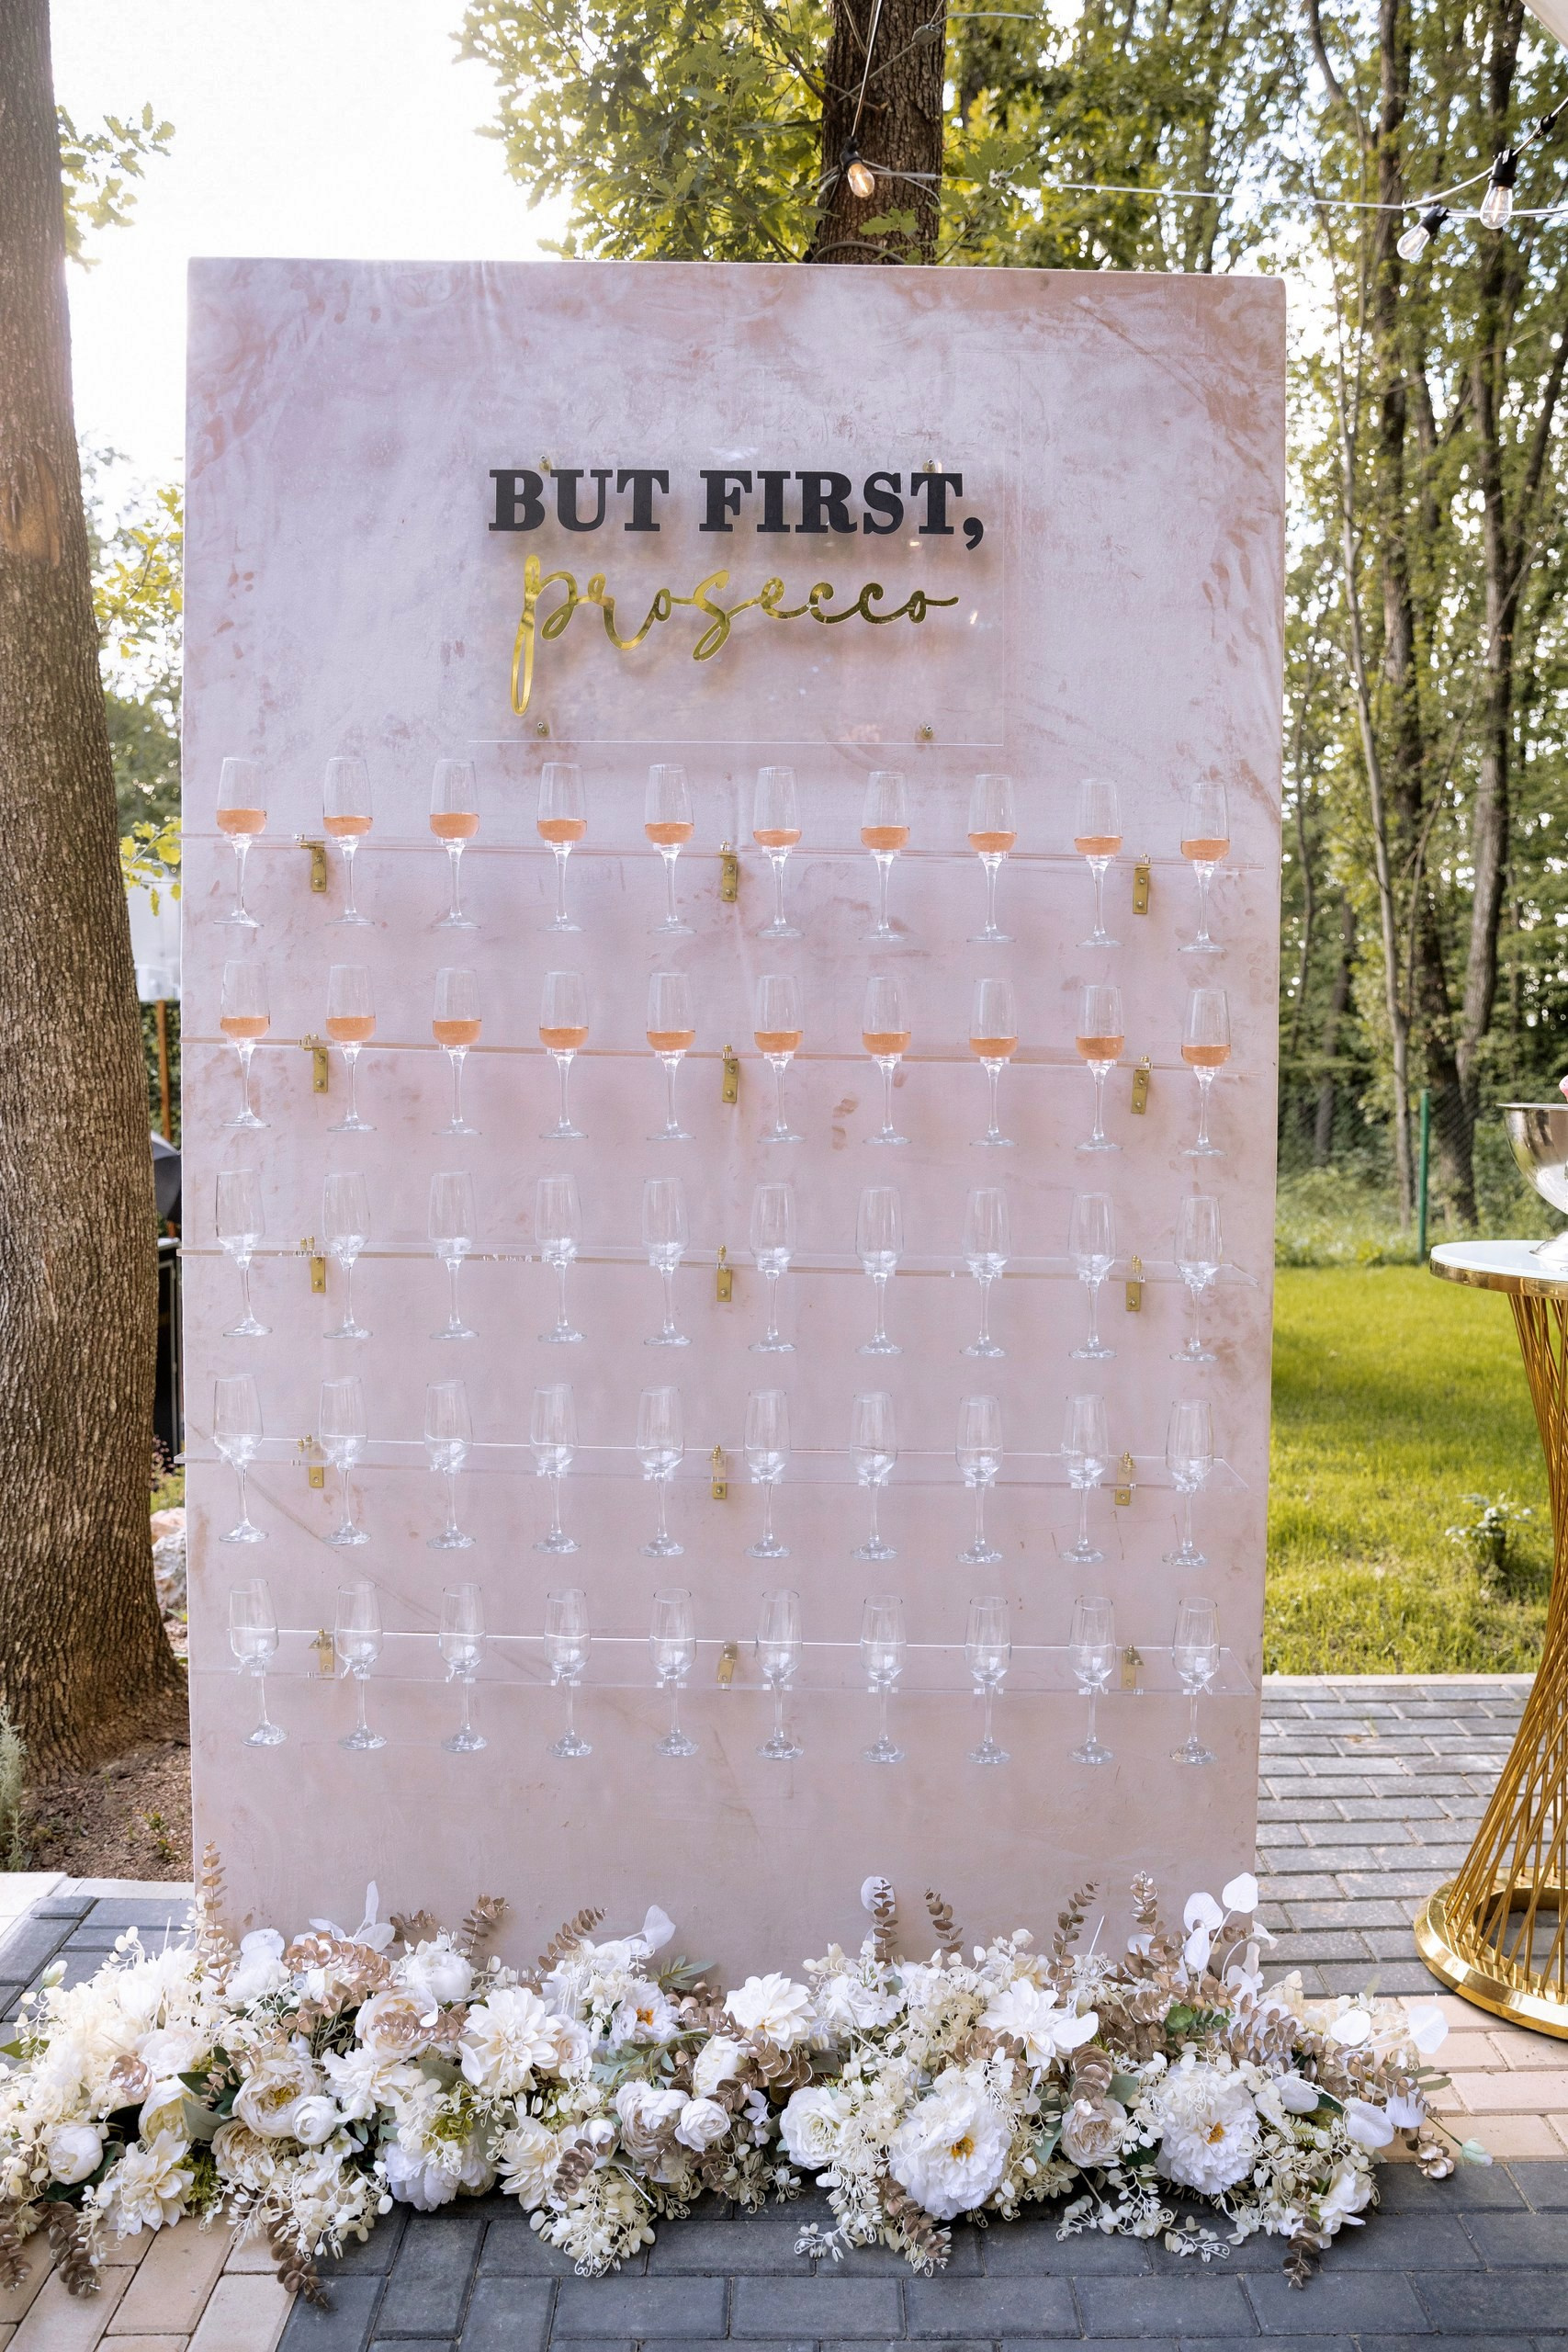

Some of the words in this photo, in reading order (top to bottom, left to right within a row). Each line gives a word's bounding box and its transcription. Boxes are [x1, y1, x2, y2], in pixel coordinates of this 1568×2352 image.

[489, 469, 669, 532] BUT
[699, 470, 984, 549] FIRST,
[511, 555, 960, 716] prosecco
